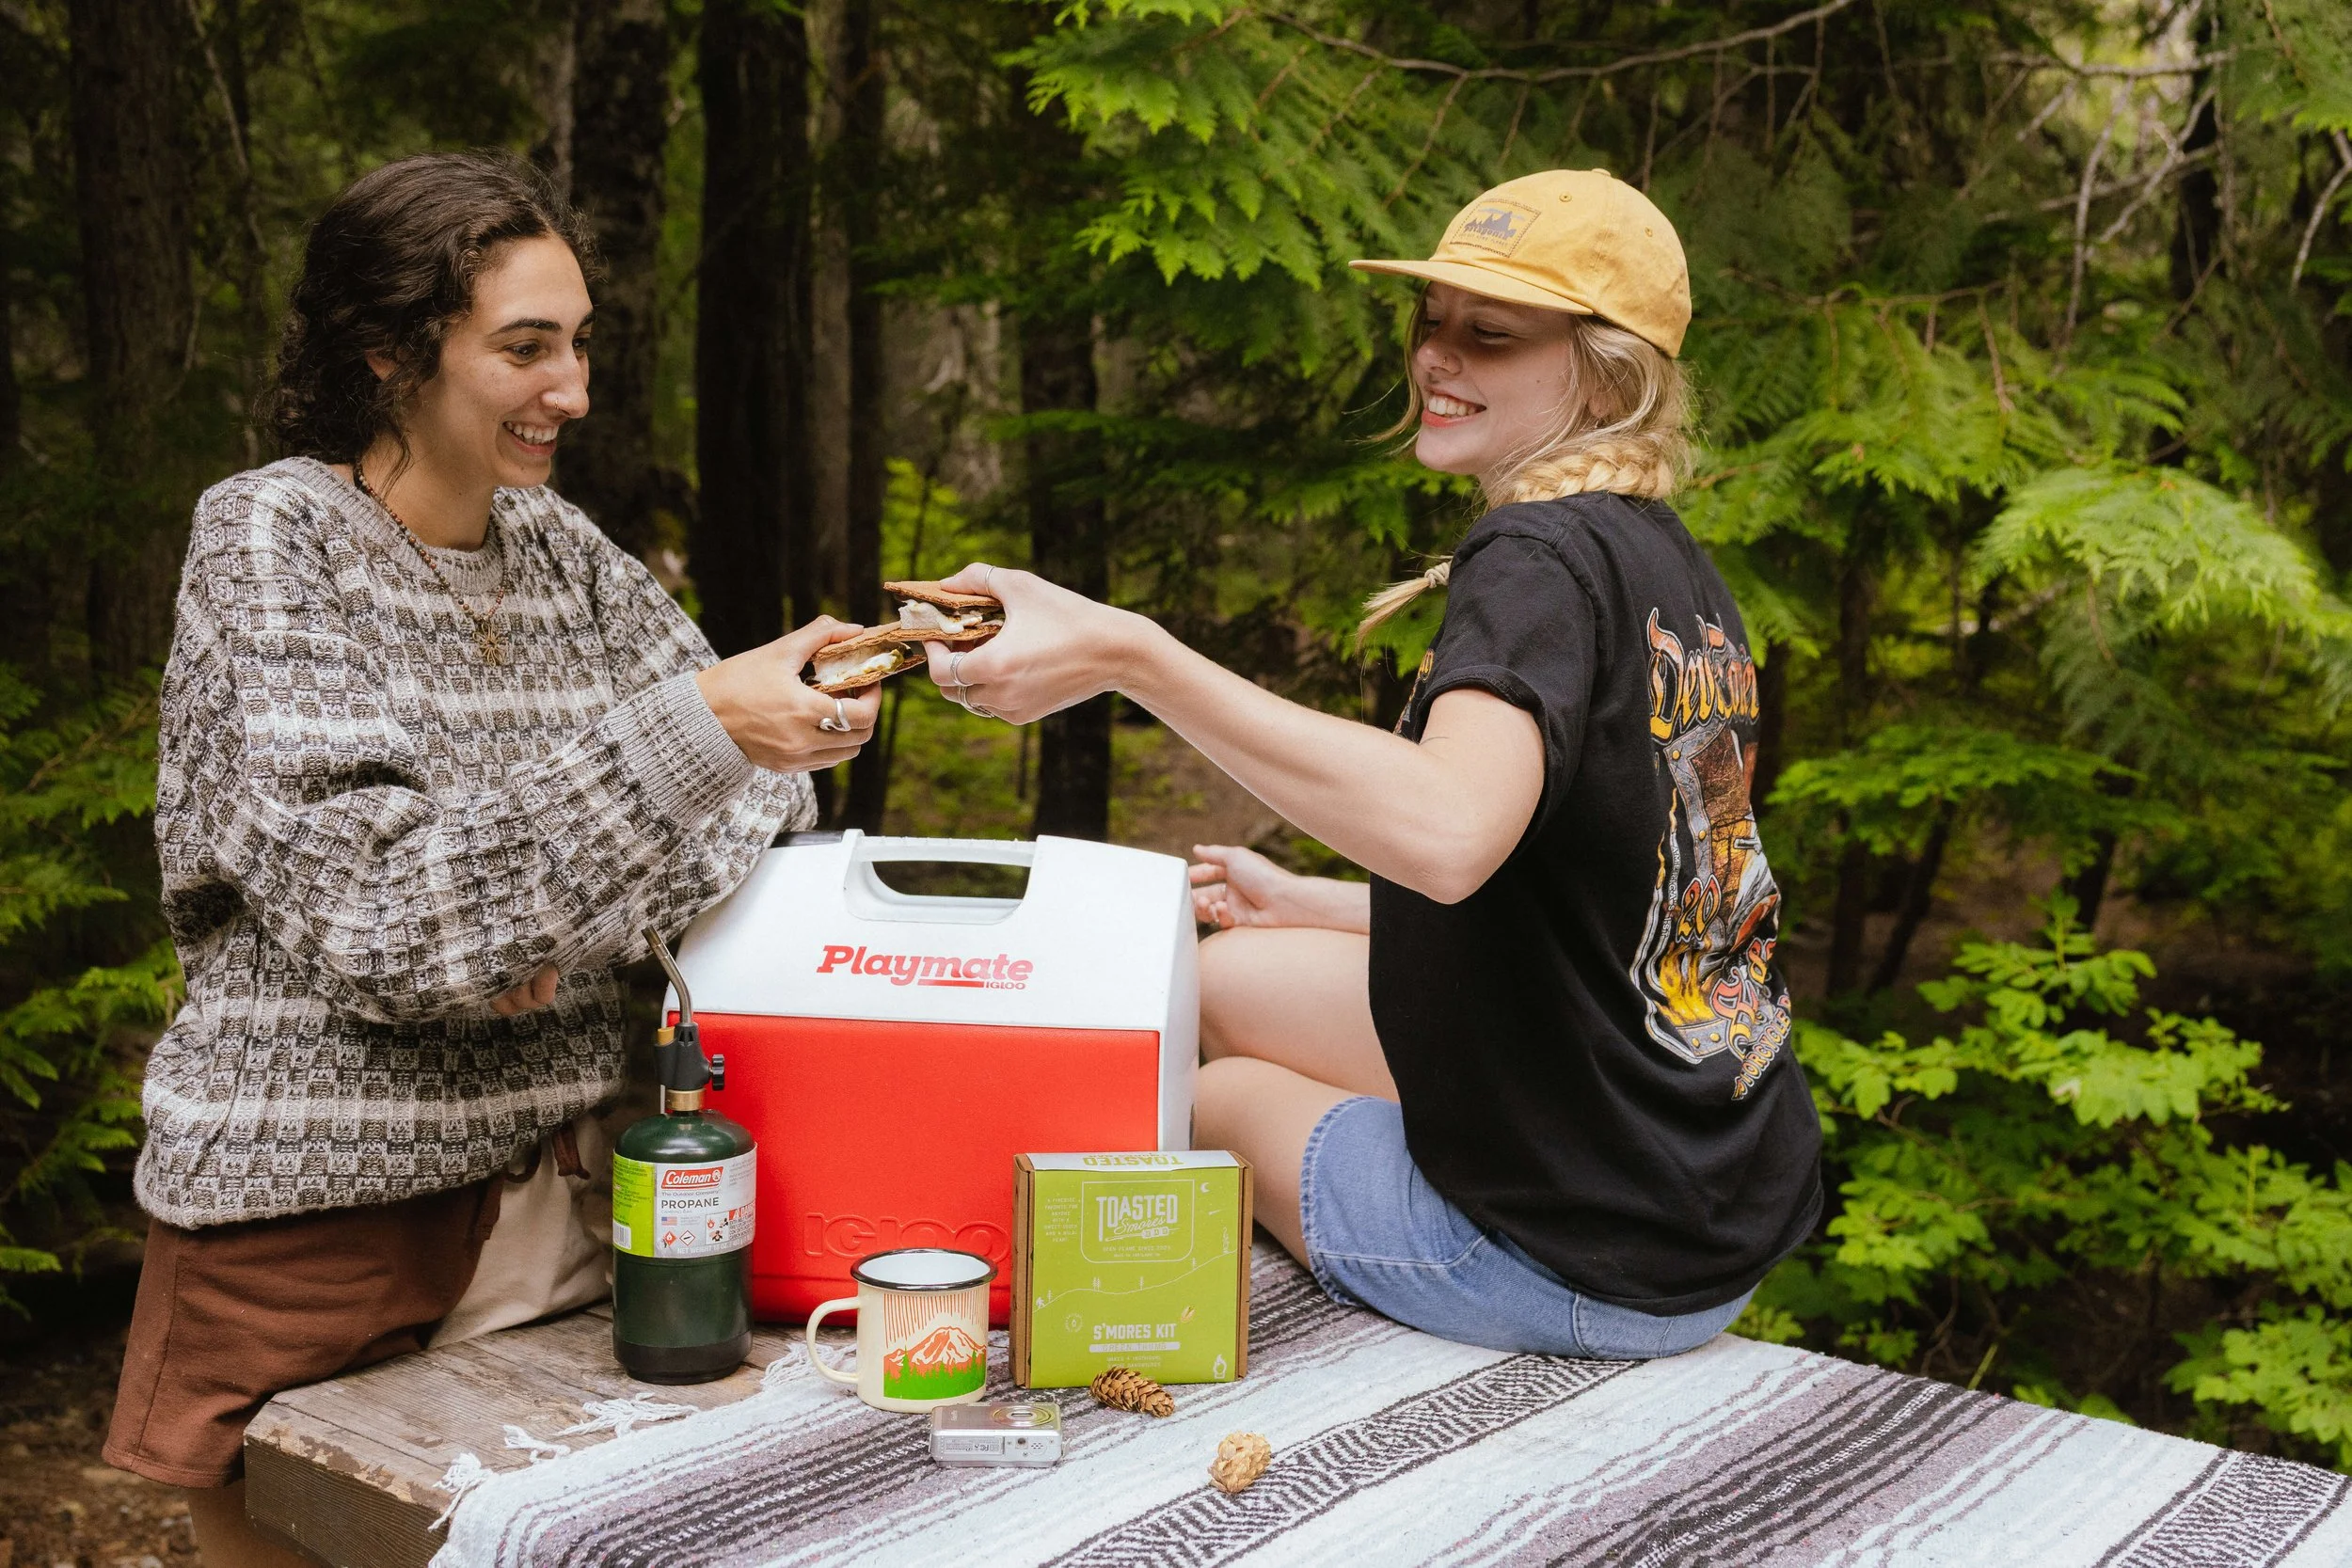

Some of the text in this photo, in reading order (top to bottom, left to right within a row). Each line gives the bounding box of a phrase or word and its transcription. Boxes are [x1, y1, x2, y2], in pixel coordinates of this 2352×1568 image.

[1676, 874, 1721, 942] 20
[817, 944, 1033, 986] Playmate
[985, 981, 1025, 990] IGLOO
[1083, 1155, 1184, 1165] TOASTED
[666, 1171, 711, 1185] Coleman
[661, 1196, 719, 1209] PROPANE
[1095, 1194, 1178, 1242] TOASTED
[1093, 1323, 1152, 1340] S'MORES
[1155, 1323, 1177, 1338] KIT
